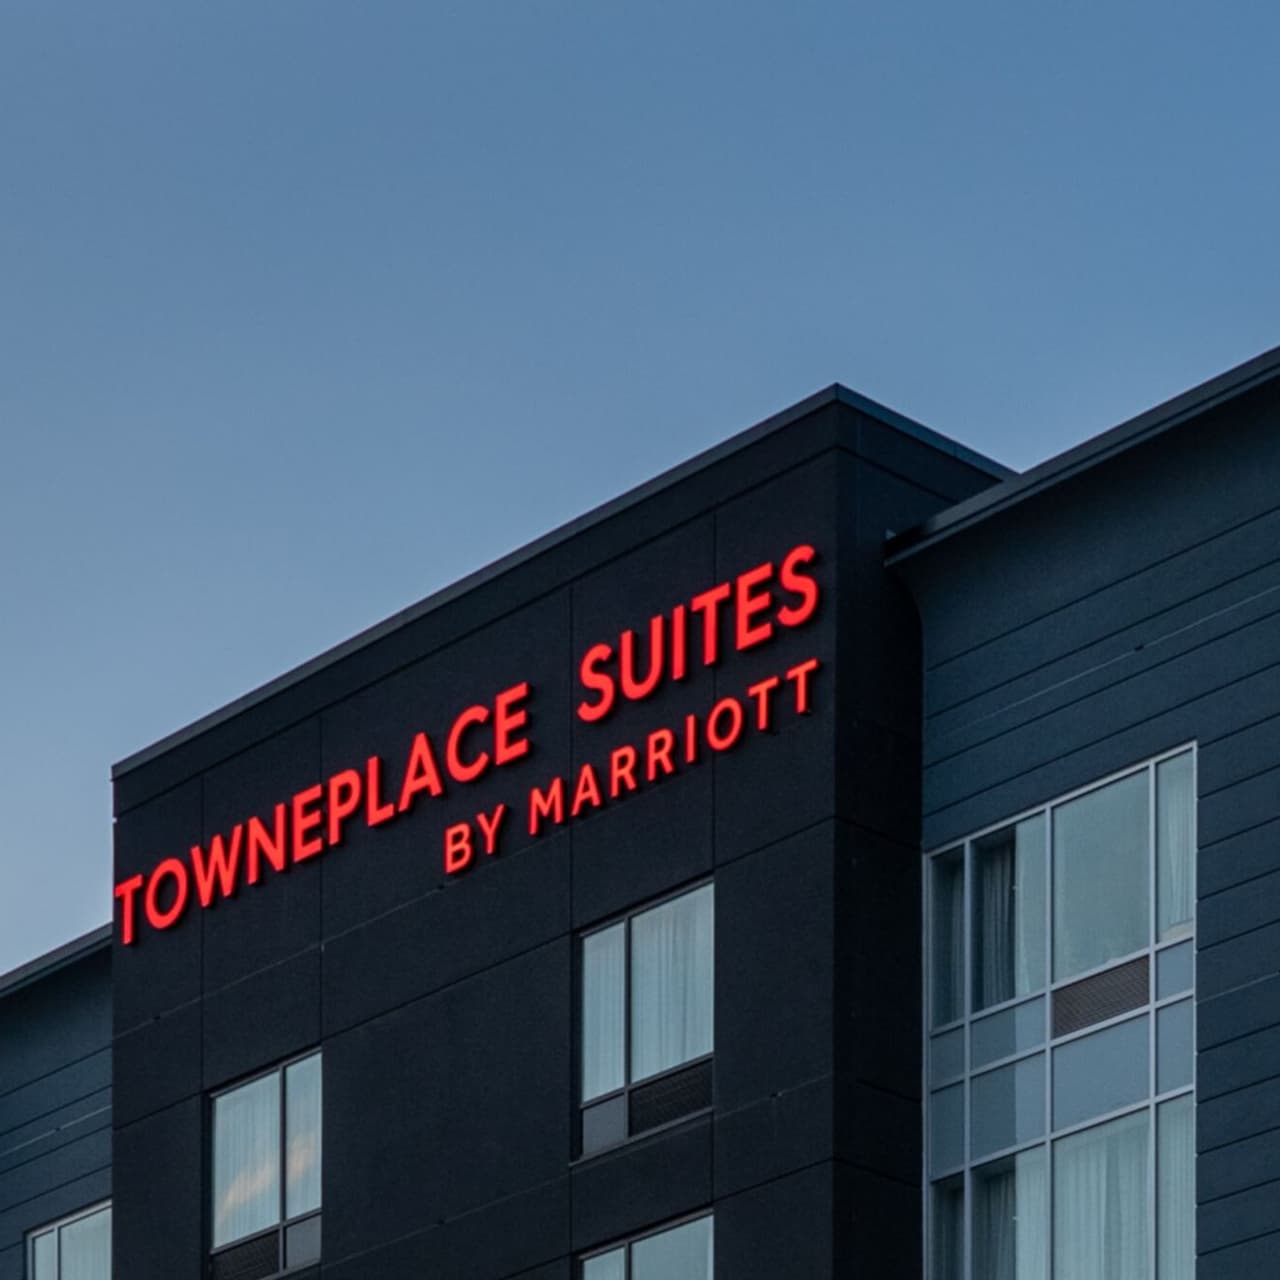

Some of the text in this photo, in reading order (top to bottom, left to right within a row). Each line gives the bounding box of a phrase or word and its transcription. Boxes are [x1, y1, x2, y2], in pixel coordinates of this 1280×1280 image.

[113, 544, 818, 945] TOWNEPLACE SUITES
[444, 658, 818, 873] BY MARRIOTT
